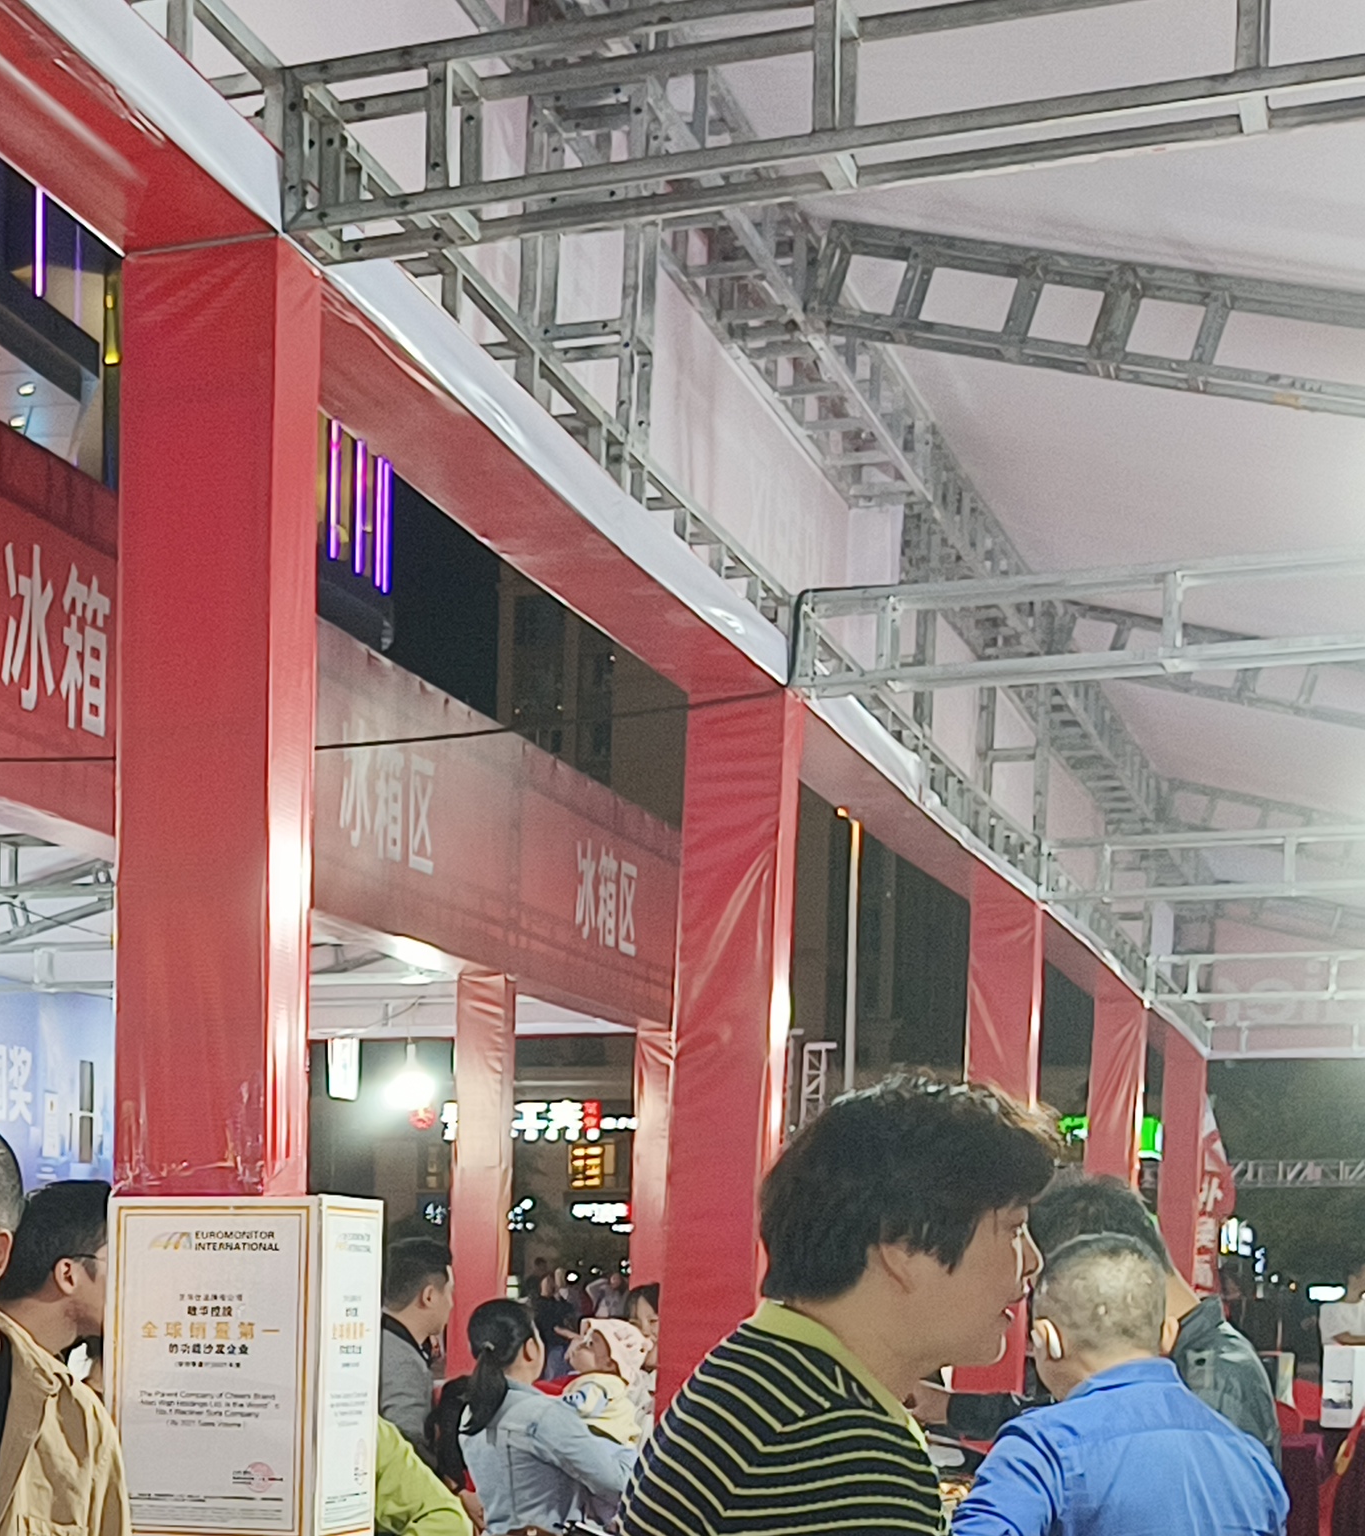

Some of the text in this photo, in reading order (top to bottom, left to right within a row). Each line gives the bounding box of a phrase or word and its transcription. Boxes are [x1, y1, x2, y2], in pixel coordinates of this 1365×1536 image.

[1, 541, 111, 738] 冰箱
[339, 719, 436, 876] 冰箱区
[575, 839, 638, 957] 冰箱区
[194, 1242, 280, 1251] INTERNATIONAL
[195, 1230, 275, 1240] EUROMONITOR
[141, 1321, 280, 1340] 全球销量第一
